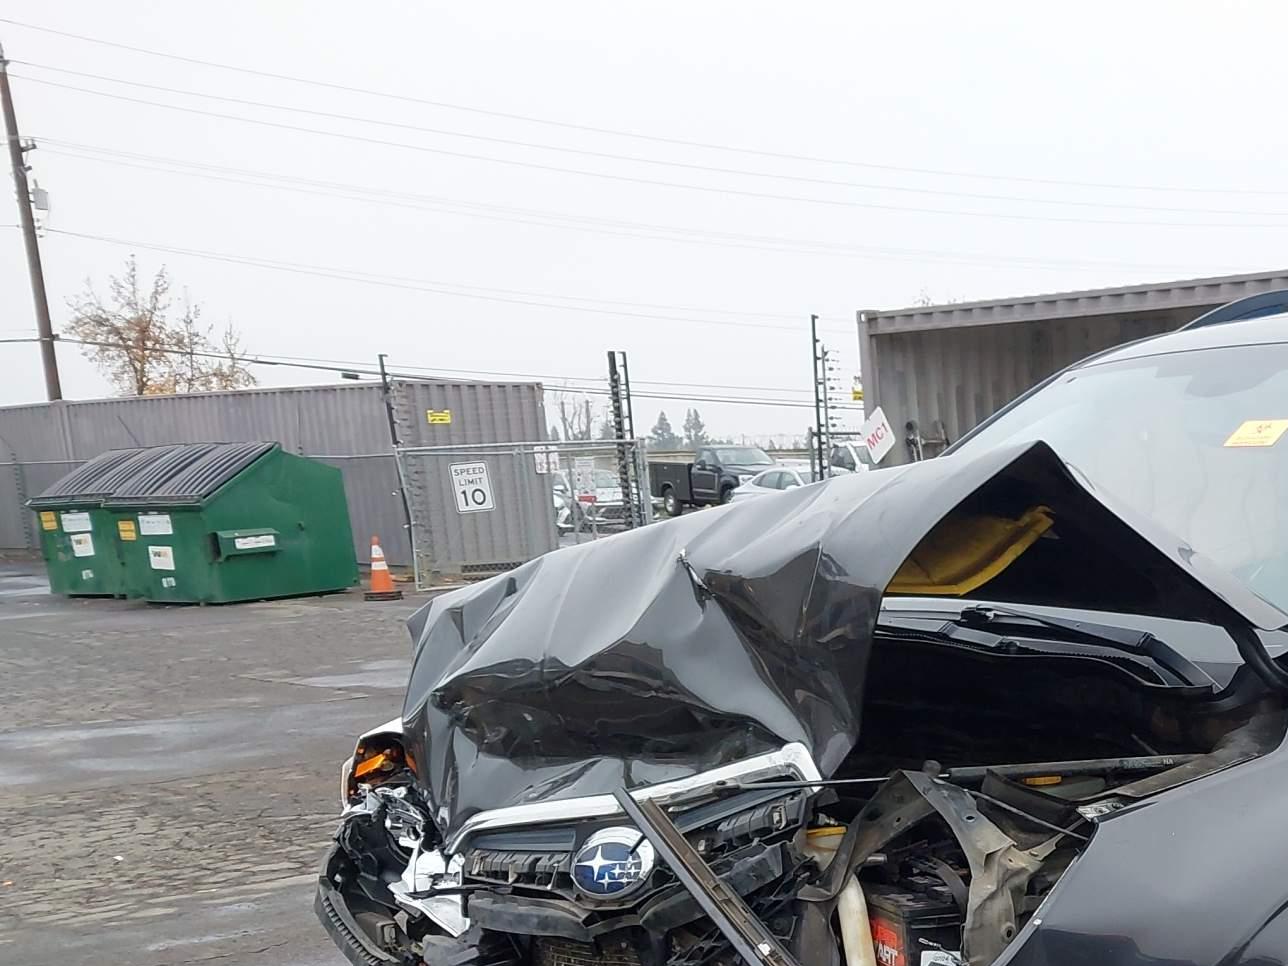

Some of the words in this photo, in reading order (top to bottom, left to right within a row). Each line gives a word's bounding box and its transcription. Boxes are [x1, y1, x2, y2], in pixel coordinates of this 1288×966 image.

[866, 421, 888, 449] MC1
[453, 467, 484, 476] SPEED
[459, 477, 482, 487] LIMIT
[461, 488, 486, 506] 10
[877, 942, 898, 966] ART
